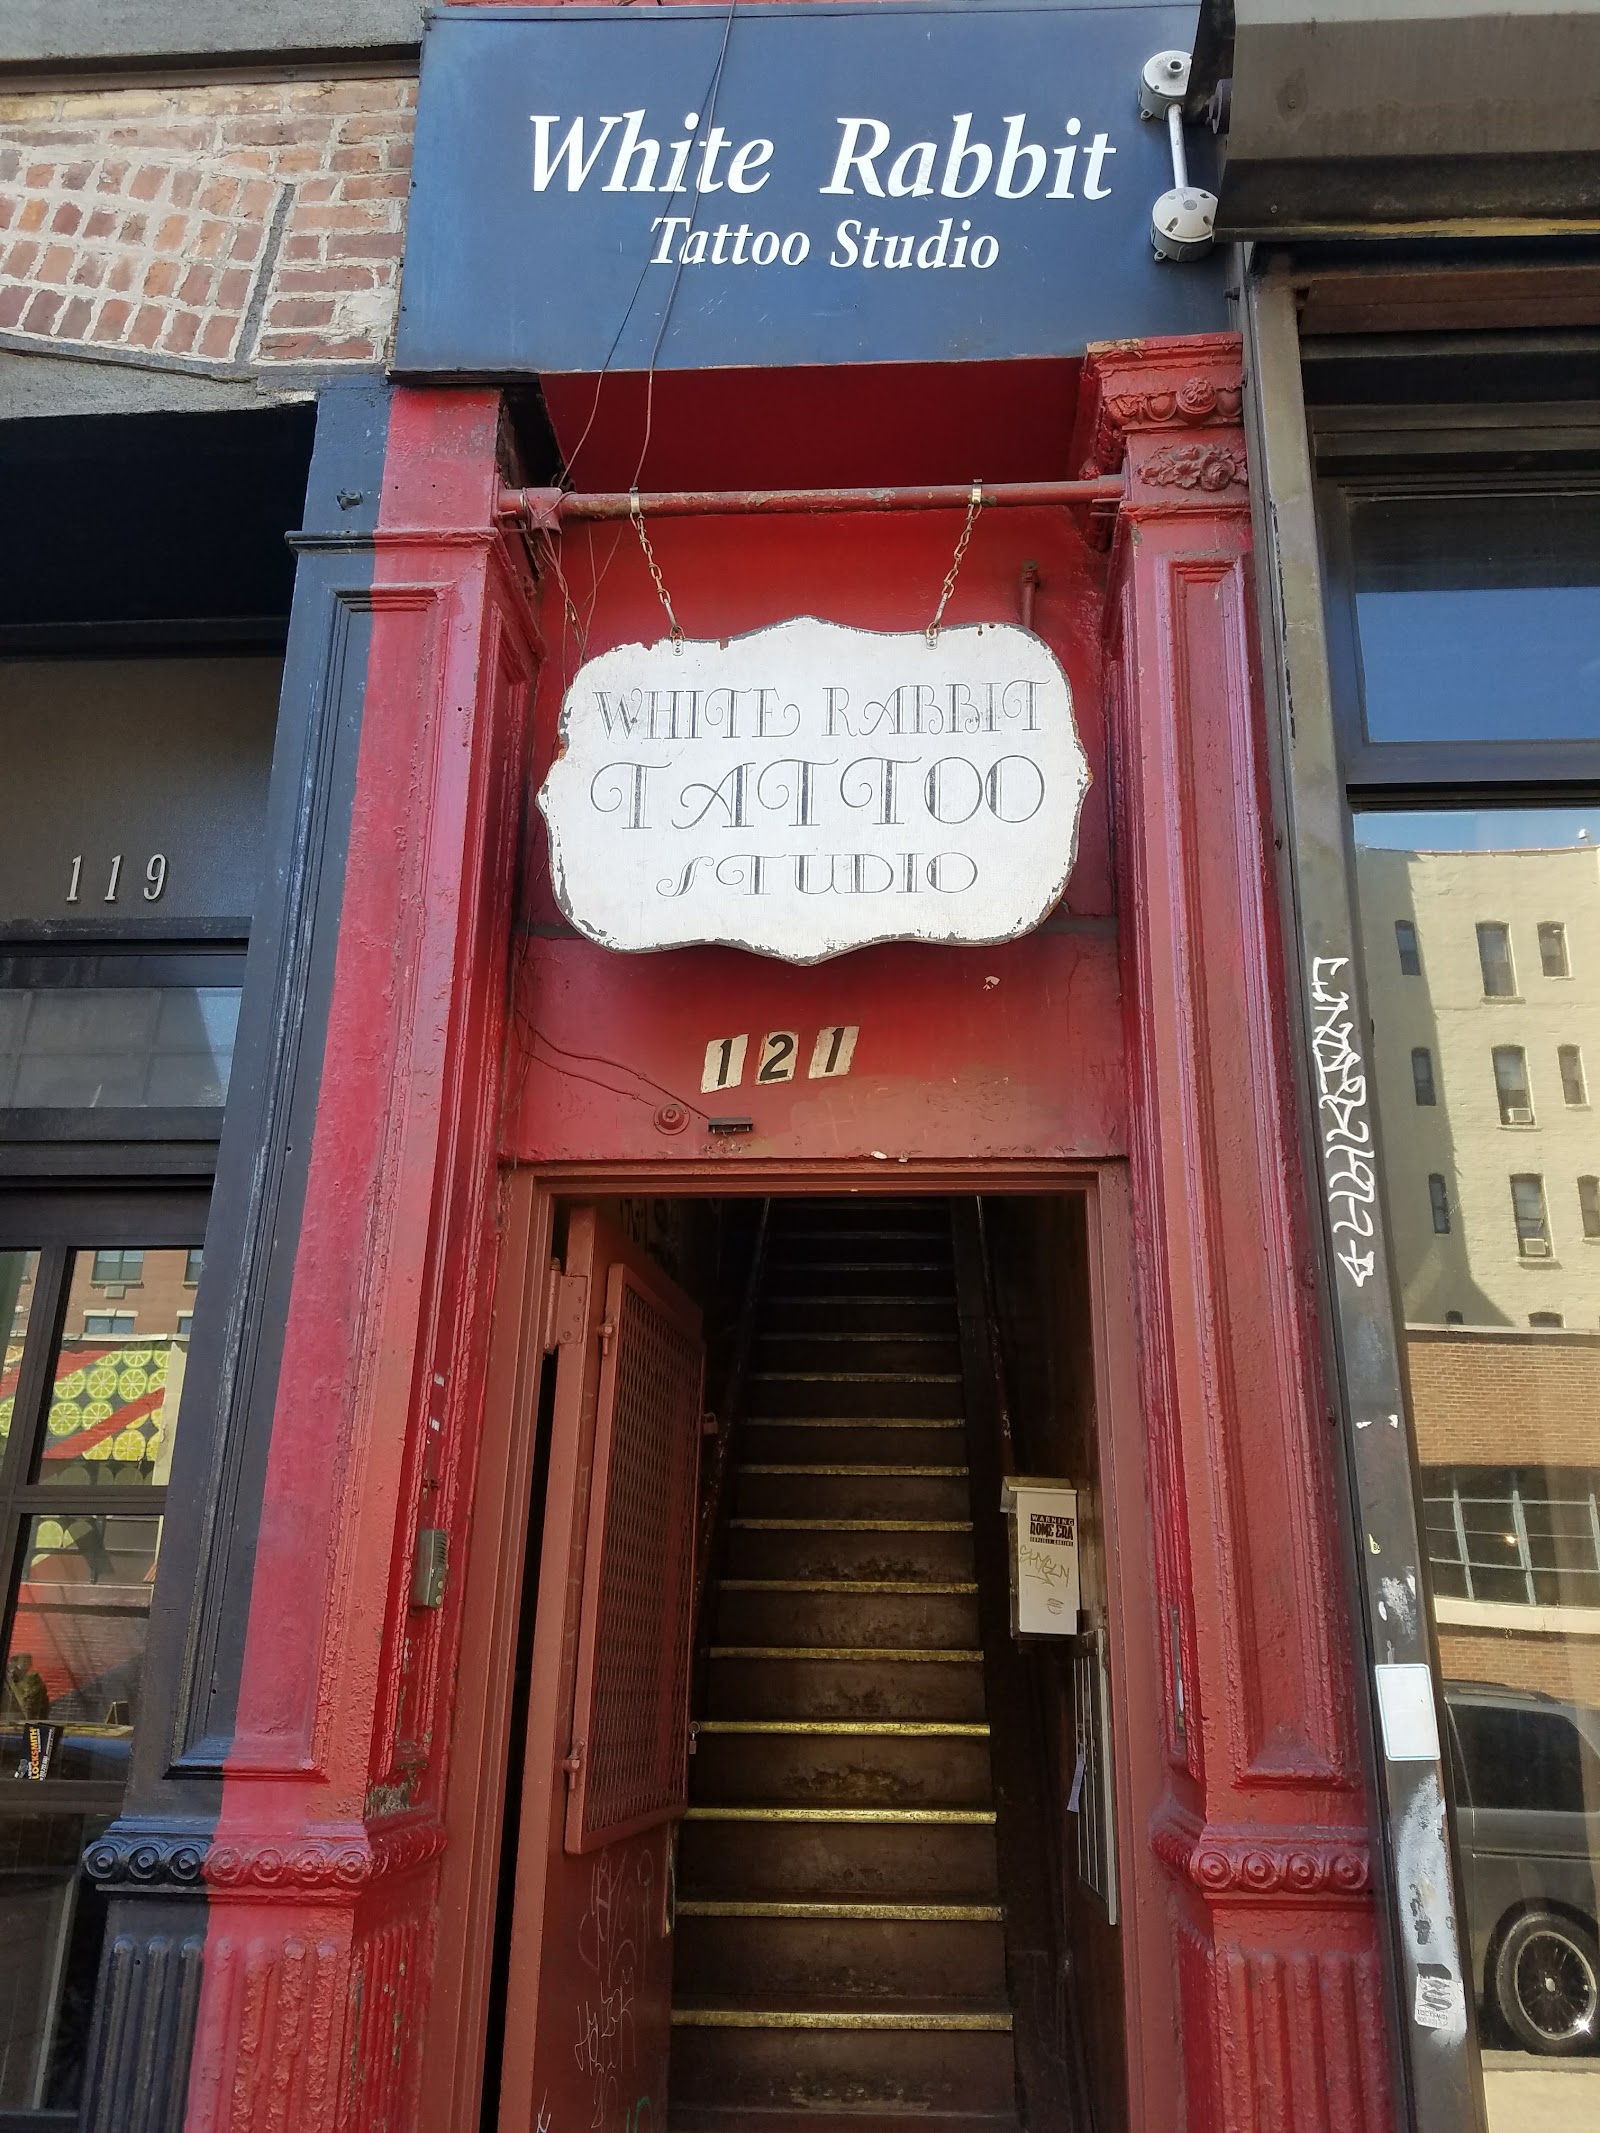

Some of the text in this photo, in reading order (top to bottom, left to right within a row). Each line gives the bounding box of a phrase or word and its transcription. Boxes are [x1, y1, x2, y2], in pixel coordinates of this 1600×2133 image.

[530, 110, 1116, 200] White Rabbit
[651, 217, 999, 269] Tattoo Studio
[592, 679, 1051, 741] WHITE RABBIT
[590, 755, 1045, 830] TATTOO
[65, 853, 167, 902] 119
[656, 852, 978, 897] STUDIO
[716, 1027, 845, 1087] 121
[1031, 1514, 1074, 1526] WARNING
[29, 1727, 40, 1780] LOCKSMITH
